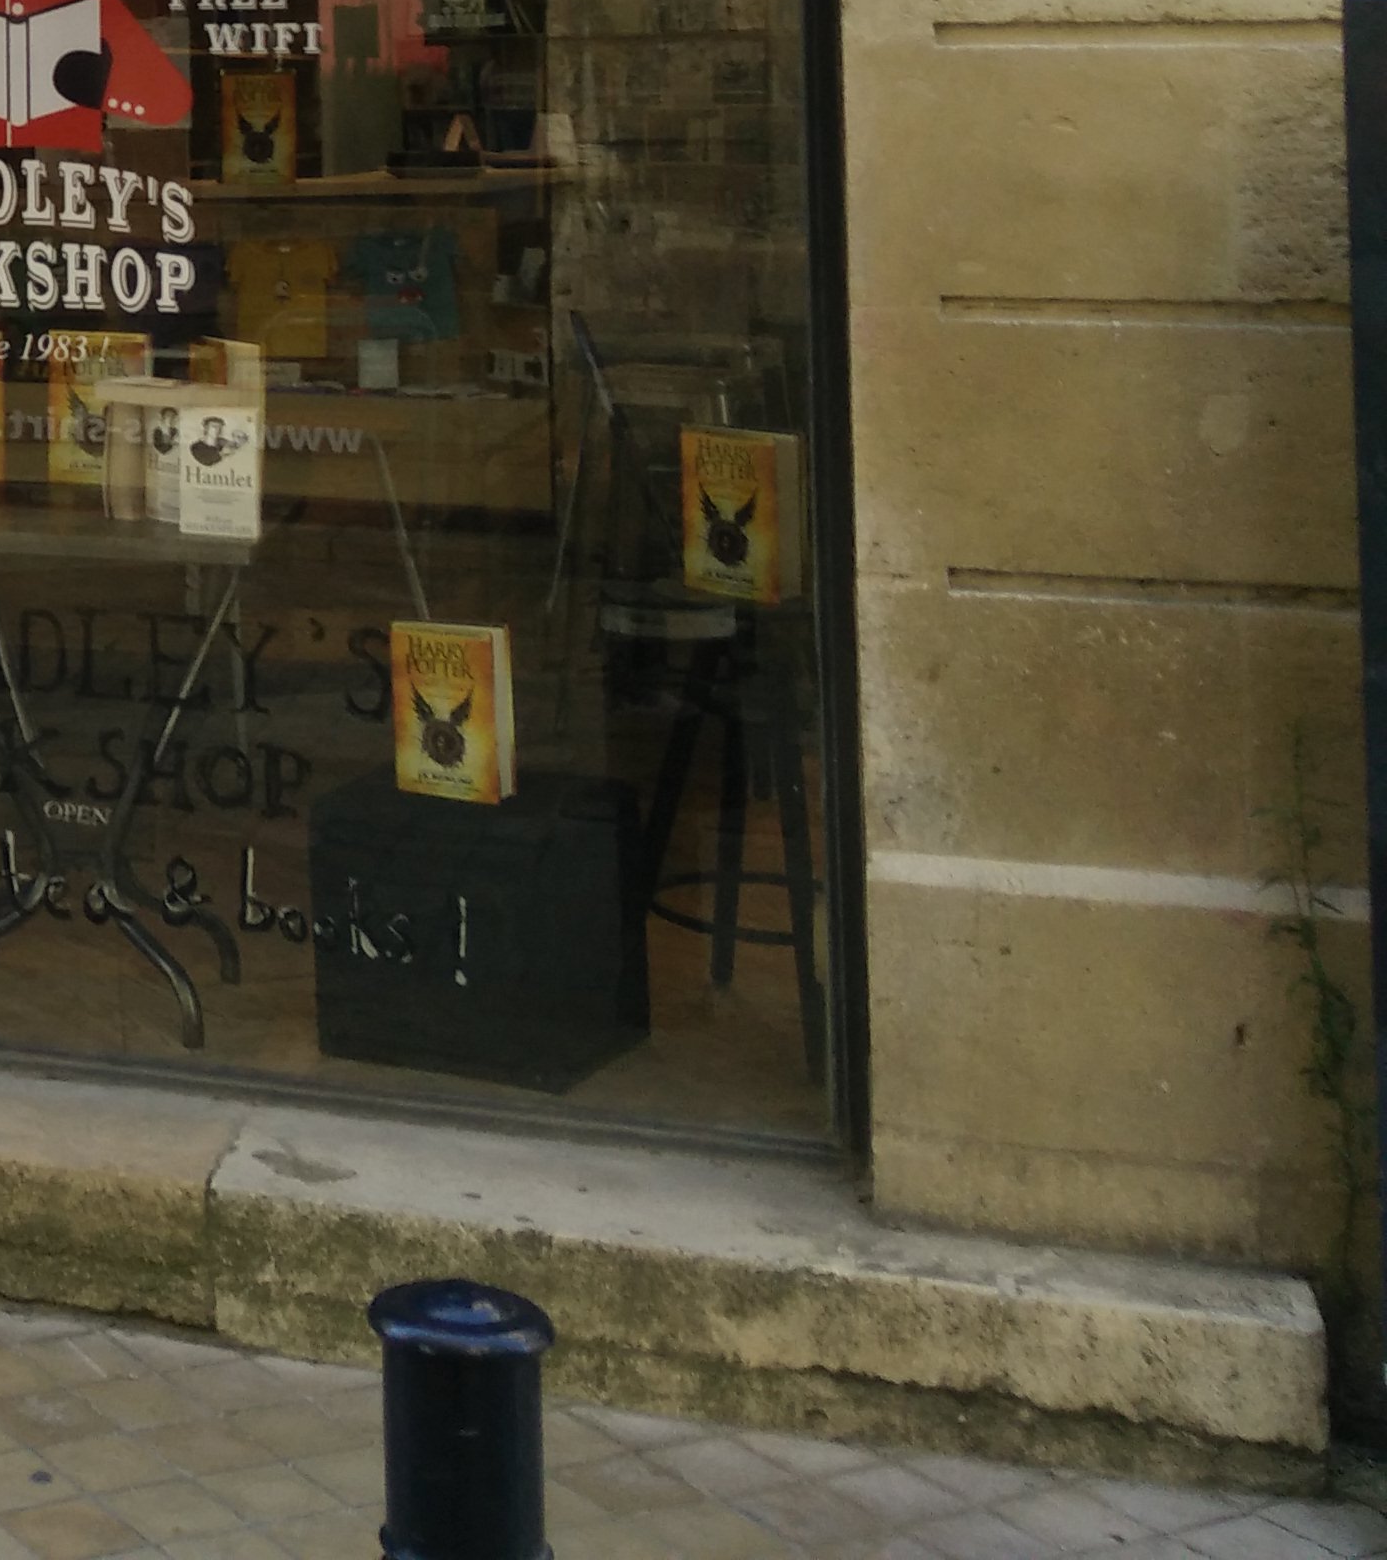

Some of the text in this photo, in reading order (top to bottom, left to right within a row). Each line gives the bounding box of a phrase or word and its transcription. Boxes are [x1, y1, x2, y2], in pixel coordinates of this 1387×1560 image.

[203, 22, 324, 56] WIFI
[19, 332, 88, 363] 1983
[185, 464, 253, 488] Hamlet
[407, 634, 465, 662] HARRY
[405, 653, 475, 680] POTTER
[42, 799, 113, 827] OPEN
[239, 844, 414, 963] books
